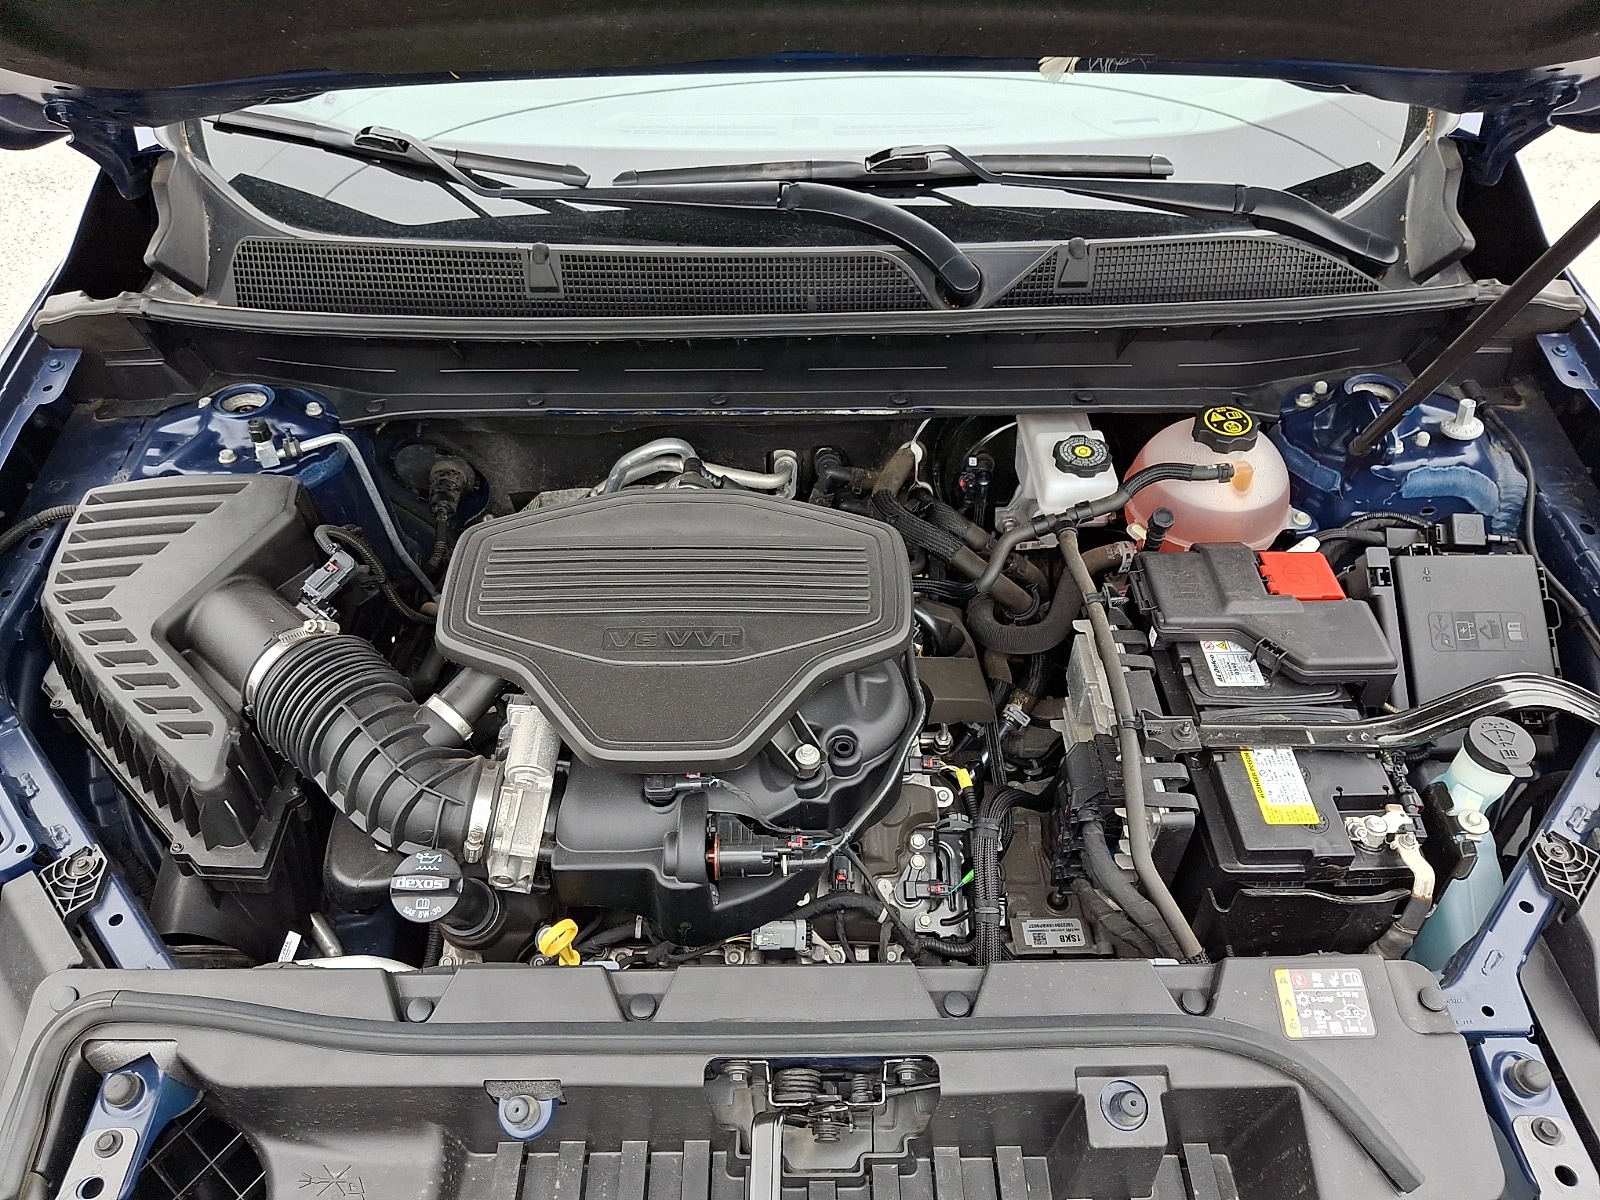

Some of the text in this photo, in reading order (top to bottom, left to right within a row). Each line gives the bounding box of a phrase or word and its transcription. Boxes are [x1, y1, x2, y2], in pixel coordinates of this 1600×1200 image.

[609, 631, 739, 647] V6 VVT
[396, 875, 444, 888] dexos
[403, 905, 442, 918] SAE 5W-30
[1059, 934, 1082, 943] 1SKB
